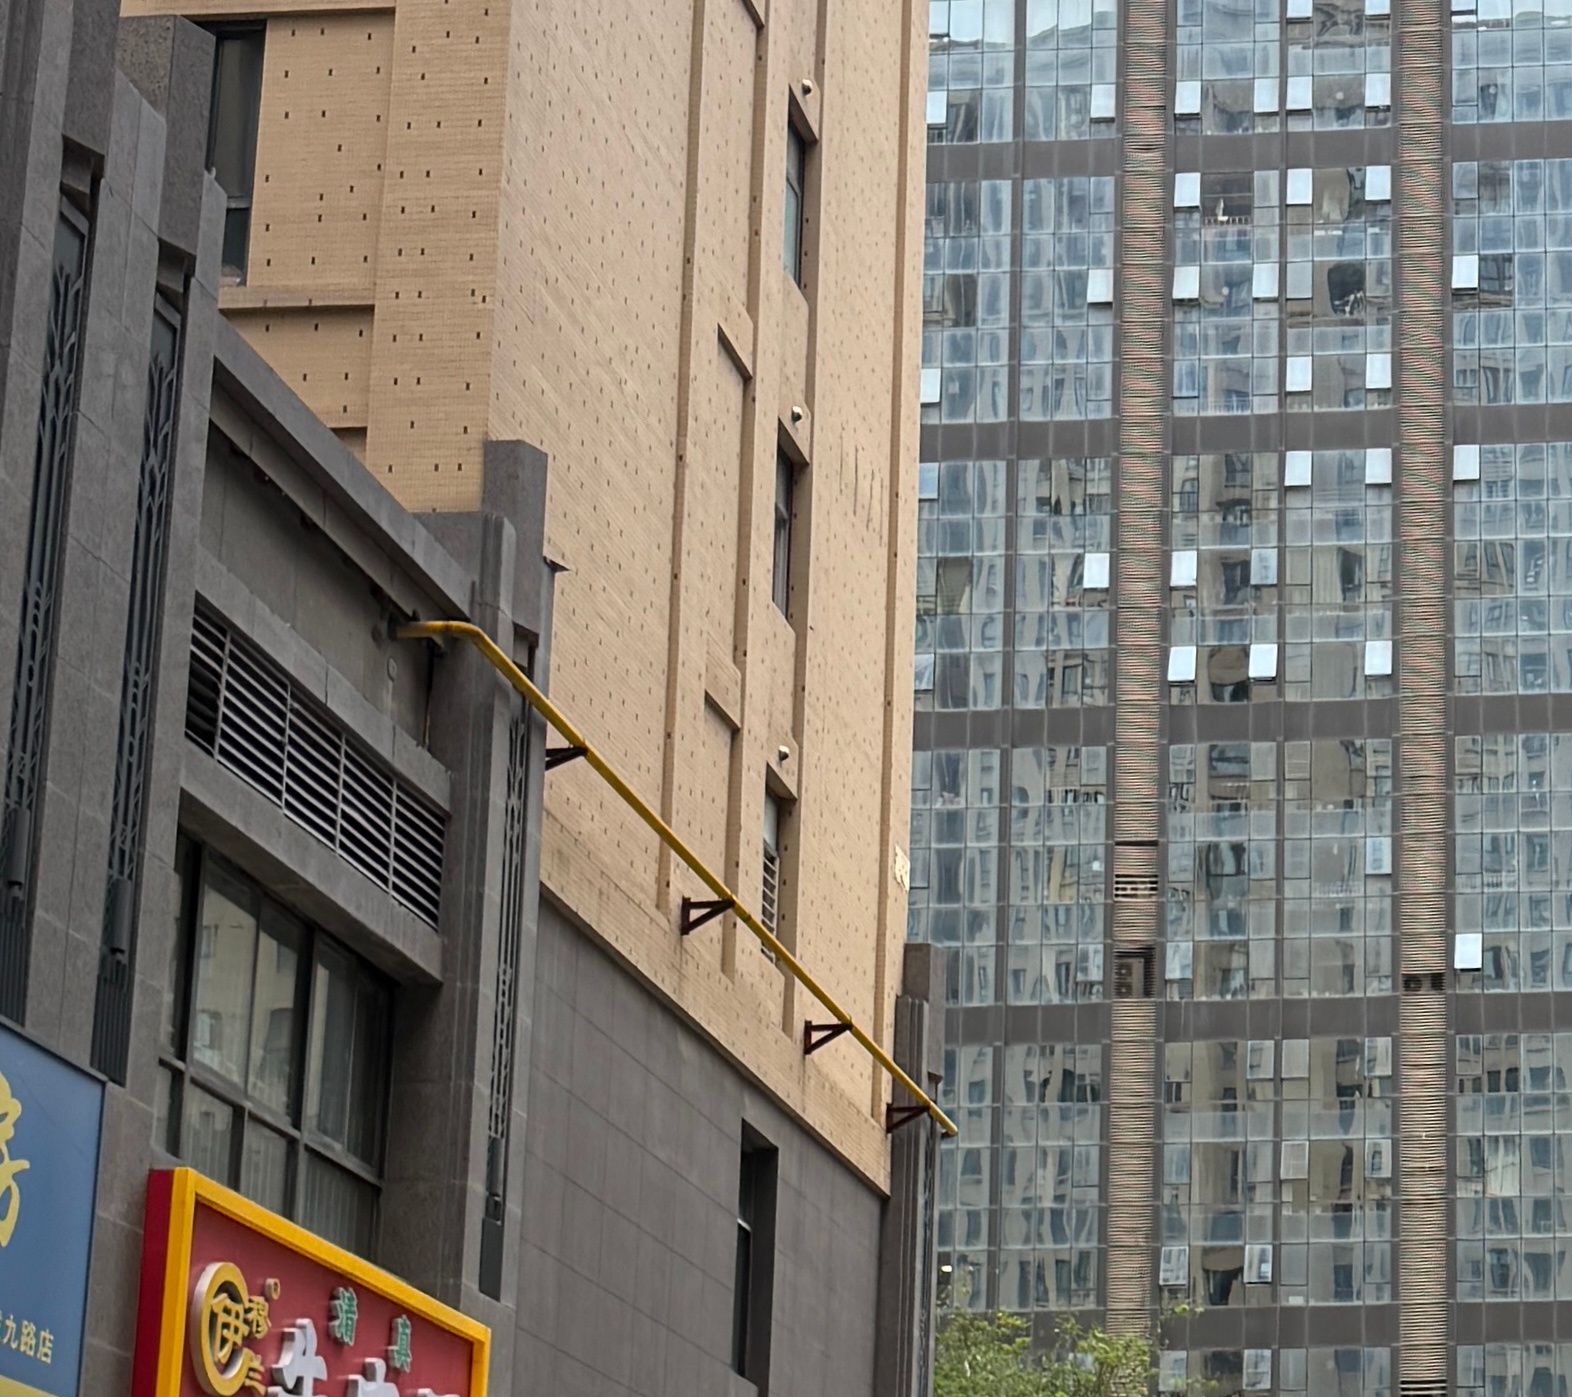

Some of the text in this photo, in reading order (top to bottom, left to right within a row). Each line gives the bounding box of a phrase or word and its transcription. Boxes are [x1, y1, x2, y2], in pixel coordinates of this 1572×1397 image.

[0, 1311, 53, 1364] 九路店
[328, 1286, 413, 1373] 清真
